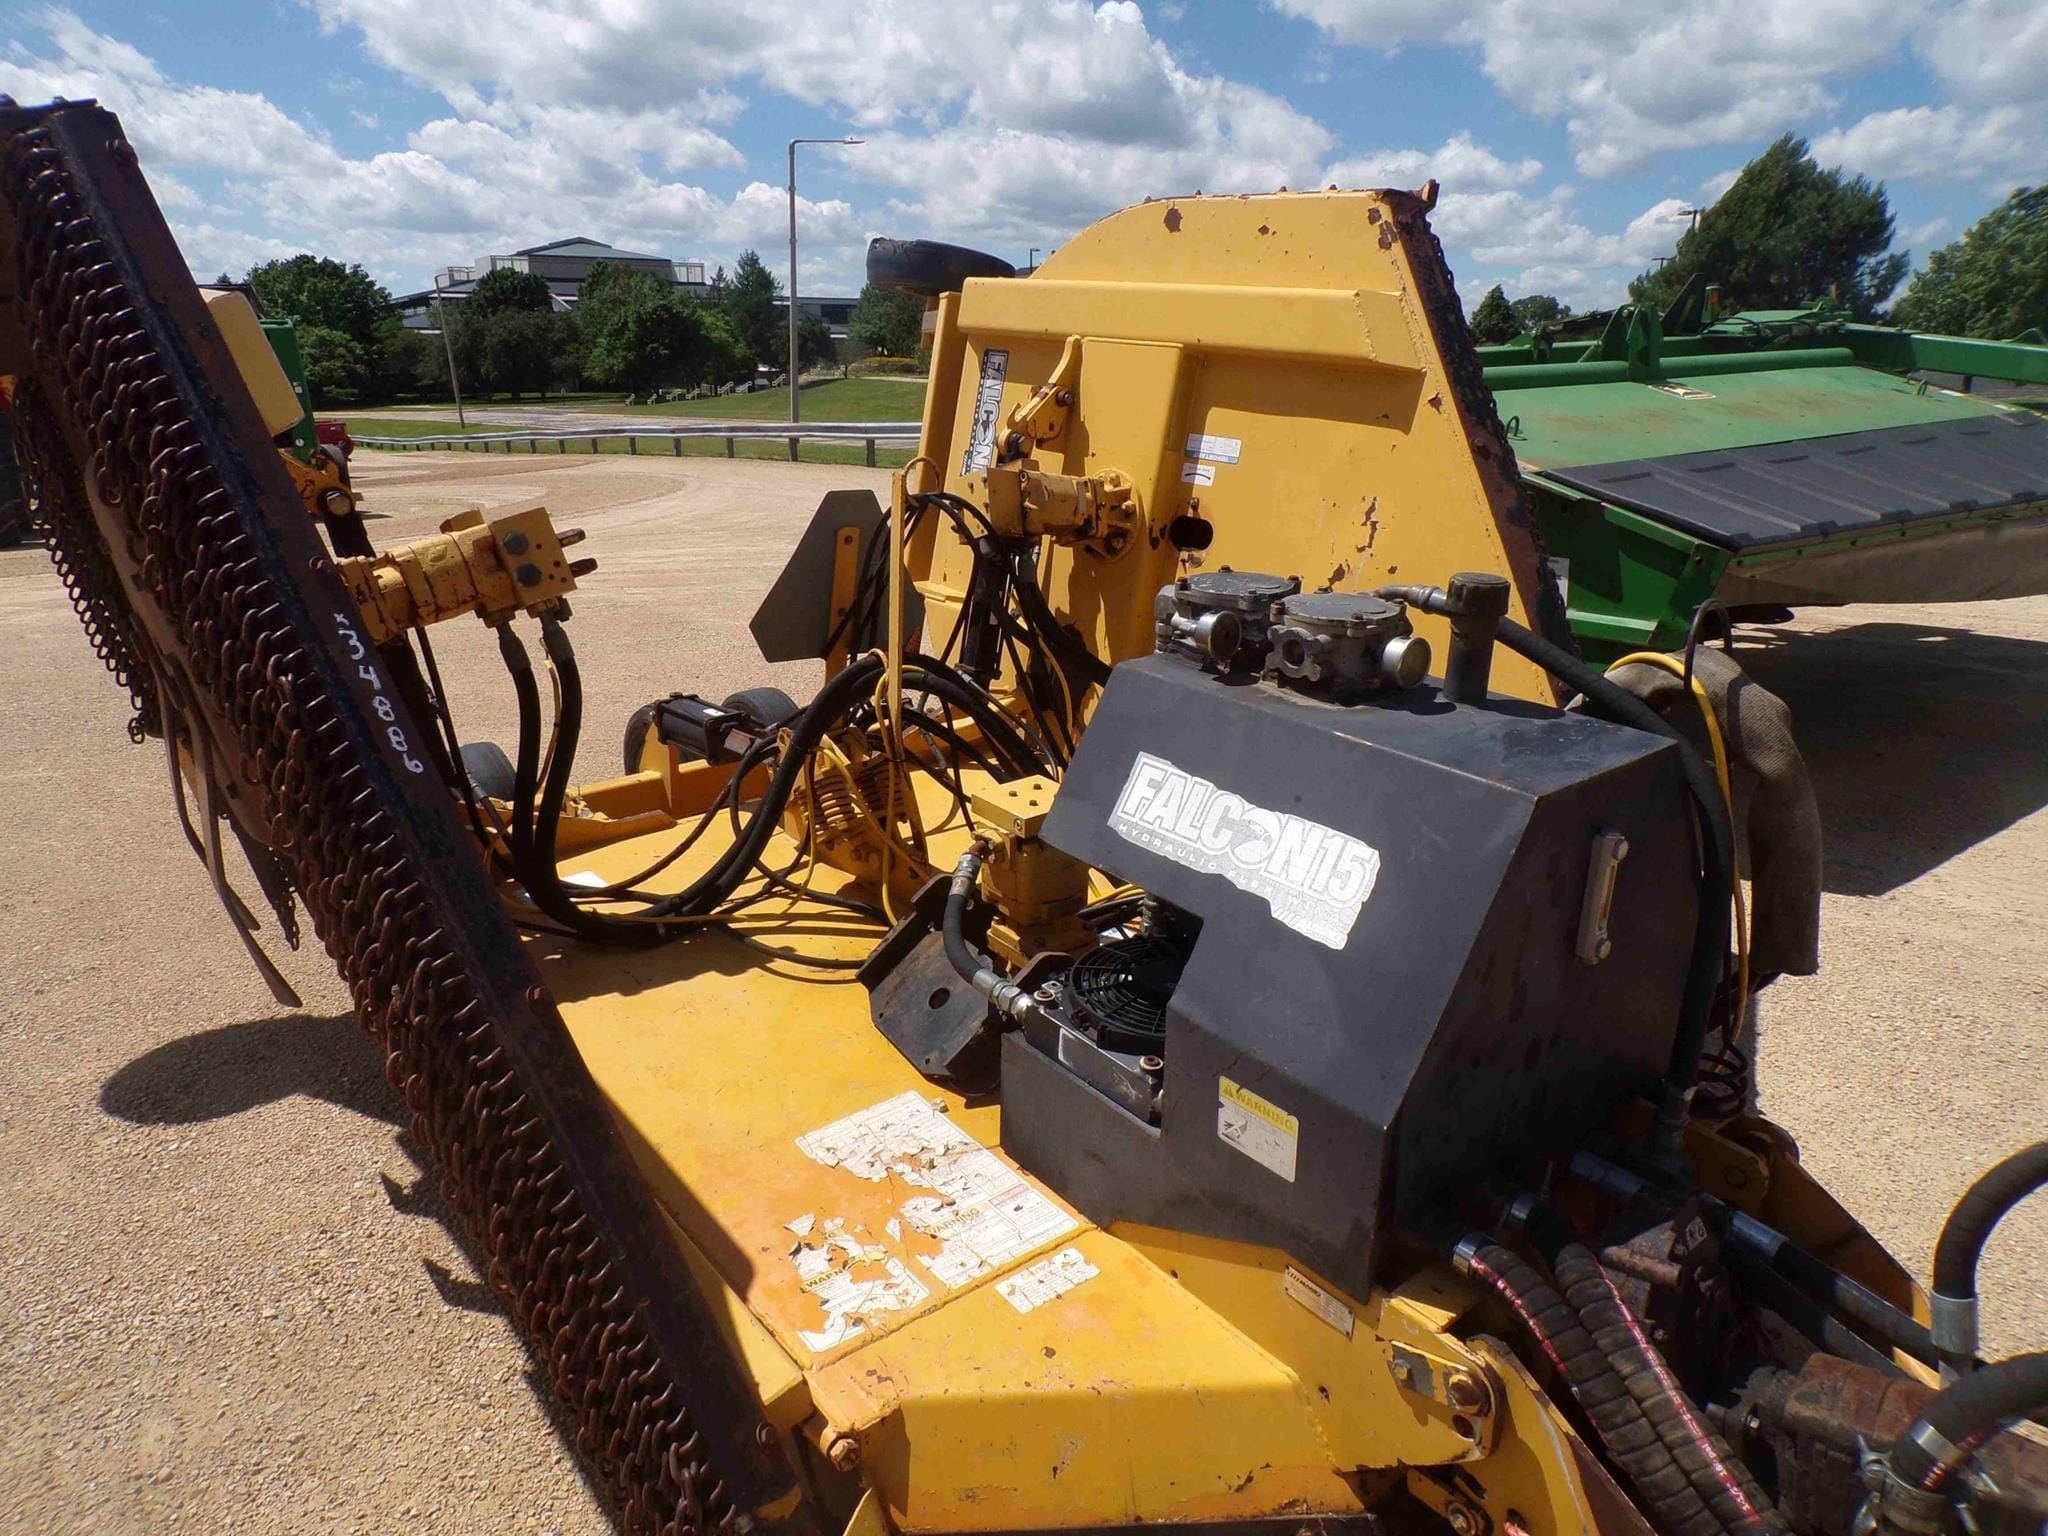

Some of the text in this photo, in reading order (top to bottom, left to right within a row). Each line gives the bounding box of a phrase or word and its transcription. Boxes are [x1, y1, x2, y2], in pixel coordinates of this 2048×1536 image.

[1117, 759, 1372, 904] FALCON15
[1118, 823, 1217, 873] HYDRAULIC
[1228, 868, 1275, 897] FLEX
[1237, 1090, 1294, 1131] WARNING
